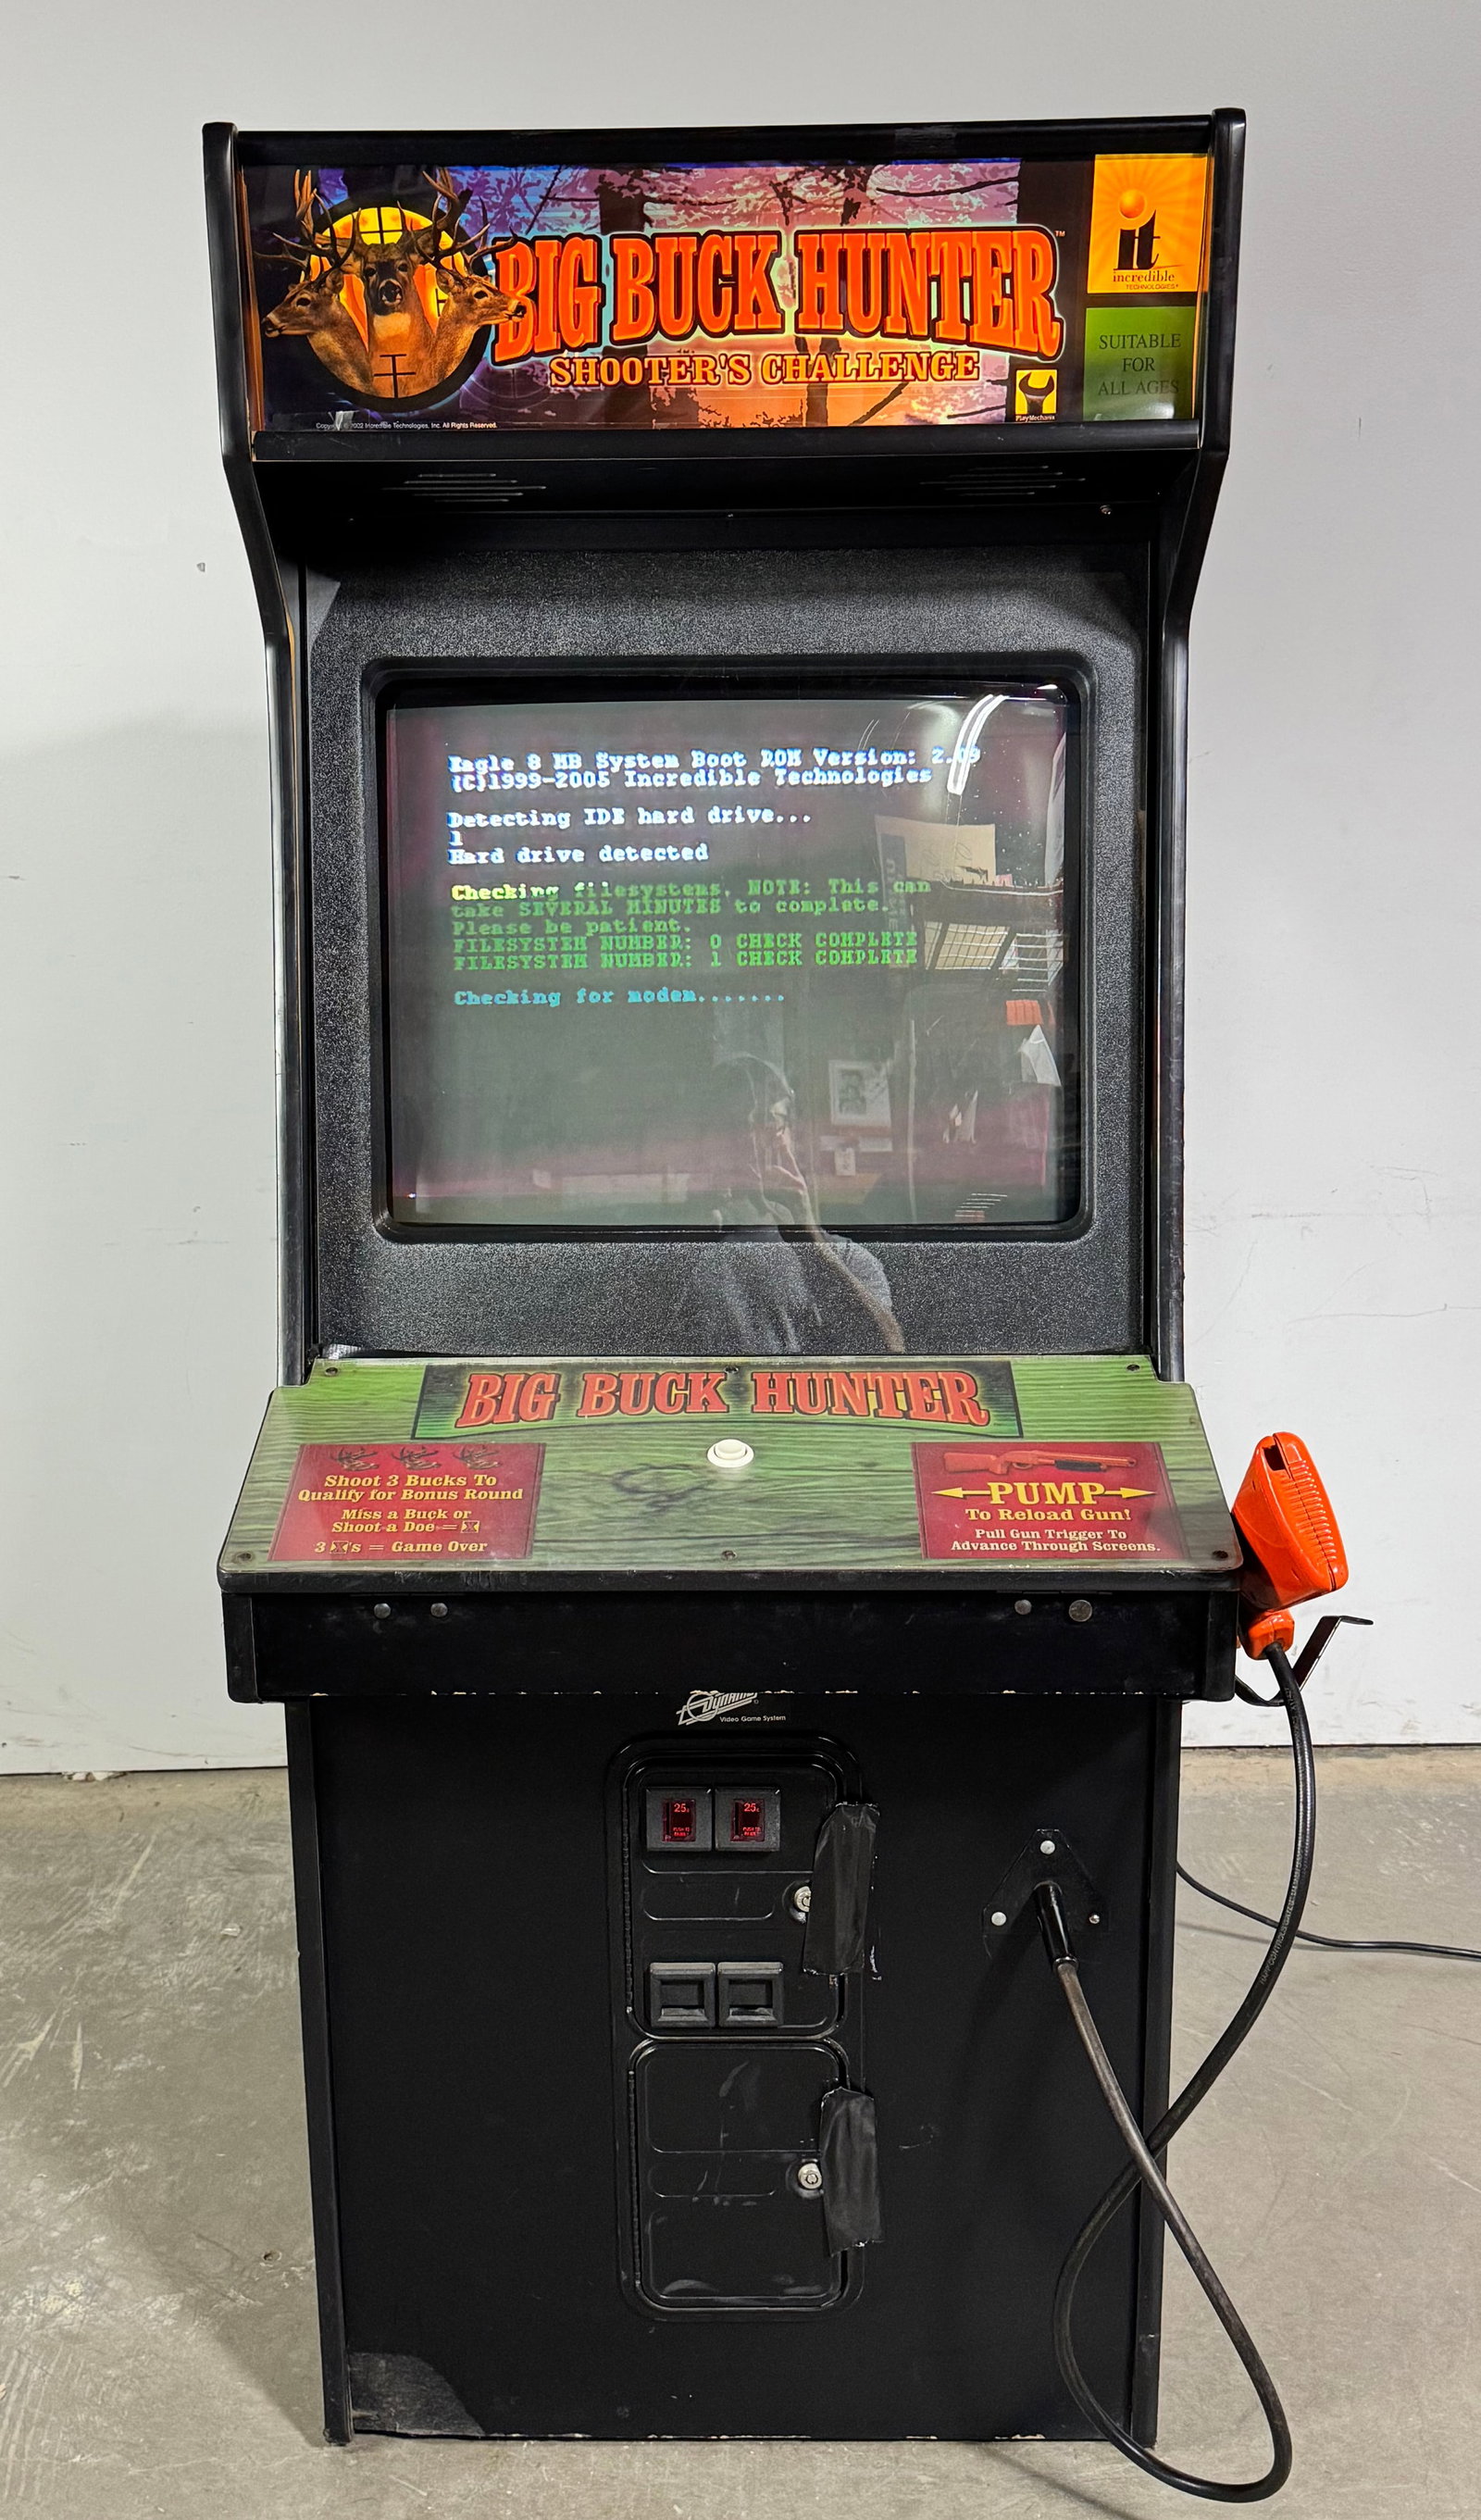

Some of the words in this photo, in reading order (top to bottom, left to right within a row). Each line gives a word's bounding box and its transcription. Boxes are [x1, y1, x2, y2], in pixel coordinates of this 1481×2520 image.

[1113, 270, 1176, 282] incredible
[493, 235, 601, 362] BIG
[610, 231, 782, 343] BUCK
[796, 230, 1062, 358] HUNTER
[1099, 333, 1181, 350] SUITABLE
[548, 354, 753, 389] SHOOTER'S
[761, 352, 980, 383] CHALLENGE
[1122, 356, 1156, 372] FOR
[1098, 380, 1130, 396] ALL
[1135, 380, 1179, 394] AGES
[452, 421, 468, 430] Rights
[448, 753, 514, 774] Eagle
[526, 753, 541, 770] 8
[553, 752, 582, 770] MB
[596, 751, 679, 772] System
[691, 749, 746, 768] Boot
[761, 748, 802, 767] ROM
[814, 747, 916, 767] Version:
[624, 767, 761, 788] Incredible
[774, 766, 933, 787] Technologies
[446, 809, 571, 829] Detecting
[583, 807, 625, 826] IDE
[637, 806, 695, 825] hard
[707, 805, 811, 824] drive...
[447, 847, 505, 865] Hard
[516, 846, 585, 864] drive
[598, 842, 709, 862] detected
[451, 883, 560, 901] Checking
[747, 879, 811, 896] NOTE:
[828, 878, 879, 895] This
[891, 880, 932, 893] can
[451, 902, 504, 918] take
[518, 900, 614, 917] SEVERAL
[625, 897, 722, 915] MINUTES
[734, 899, 761, 914] to
[452, 921, 533, 936] Please
[544, 919, 573, 935] be
[585, 917, 692, 937] patient.
[453, 936, 589, 954] FILESYSTEM
[599, 934, 691, 952] NUMBER:
[736, 932, 803, 950] CHECK
[815, 931, 918, 949] COMPLETE
[453, 954, 589, 970] FILESYSTEM
[736, 950, 803, 967] CHECK
[815, 948, 918, 966] COMPLETE
[454, 989, 562, 1007] Checking
[576, 987, 615, 1003] for
[455, 1372, 561, 1428] BIG
[576, 1371, 730, 1417] BUCK
[751, 1370, 990, 1428] HUNTER
[324, 1475, 382, 1488] Shoot
[386, 1475, 399, 1488] 3
[405, 1474, 467, 1487] Bucks
[474, 1474, 498, 1486] To
[298, 1490, 365, 1503] Qualify
[369, 1490, 396, 1501] for
[401, 1489, 458, 1501] Bonus
[464, 1488, 524, 1501] Round
[988, 1482, 1105, 1505] PUMP
[342, 1509, 382, 1520] Miss
[387, 1511, 399, 1520] a
[404, 1509, 448, 1522] Buck
[454, 1510, 472, 1520] or
[965, 1509, 992, 1521] To
[998, 1508, 1074, 1521] Reload
[1080, 1508, 1132, 1521] Gun!
[331, 1521, 381, 1533] Shoot
[385, 1523, 398, 1533] a
[404, 1521, 435, 1533] Doe
[975, 1529, 1005, 1540] Pull
[1010, 1529, 1041, 1540] Gun
[1044, 1529, 1103, 1541] Trigger
[1108, 1529, 1127, 1540] To
[315, 1541, 326, 1553] 3
[391, 1541, 442, 1553] Game
[447, 1541, 489, 1553] Over
[951, 1541, 1018, 1552] Advance
[1021, 1541, 1089, 1553] Through
[1092, 1540, 1161, 1552] Screens.
